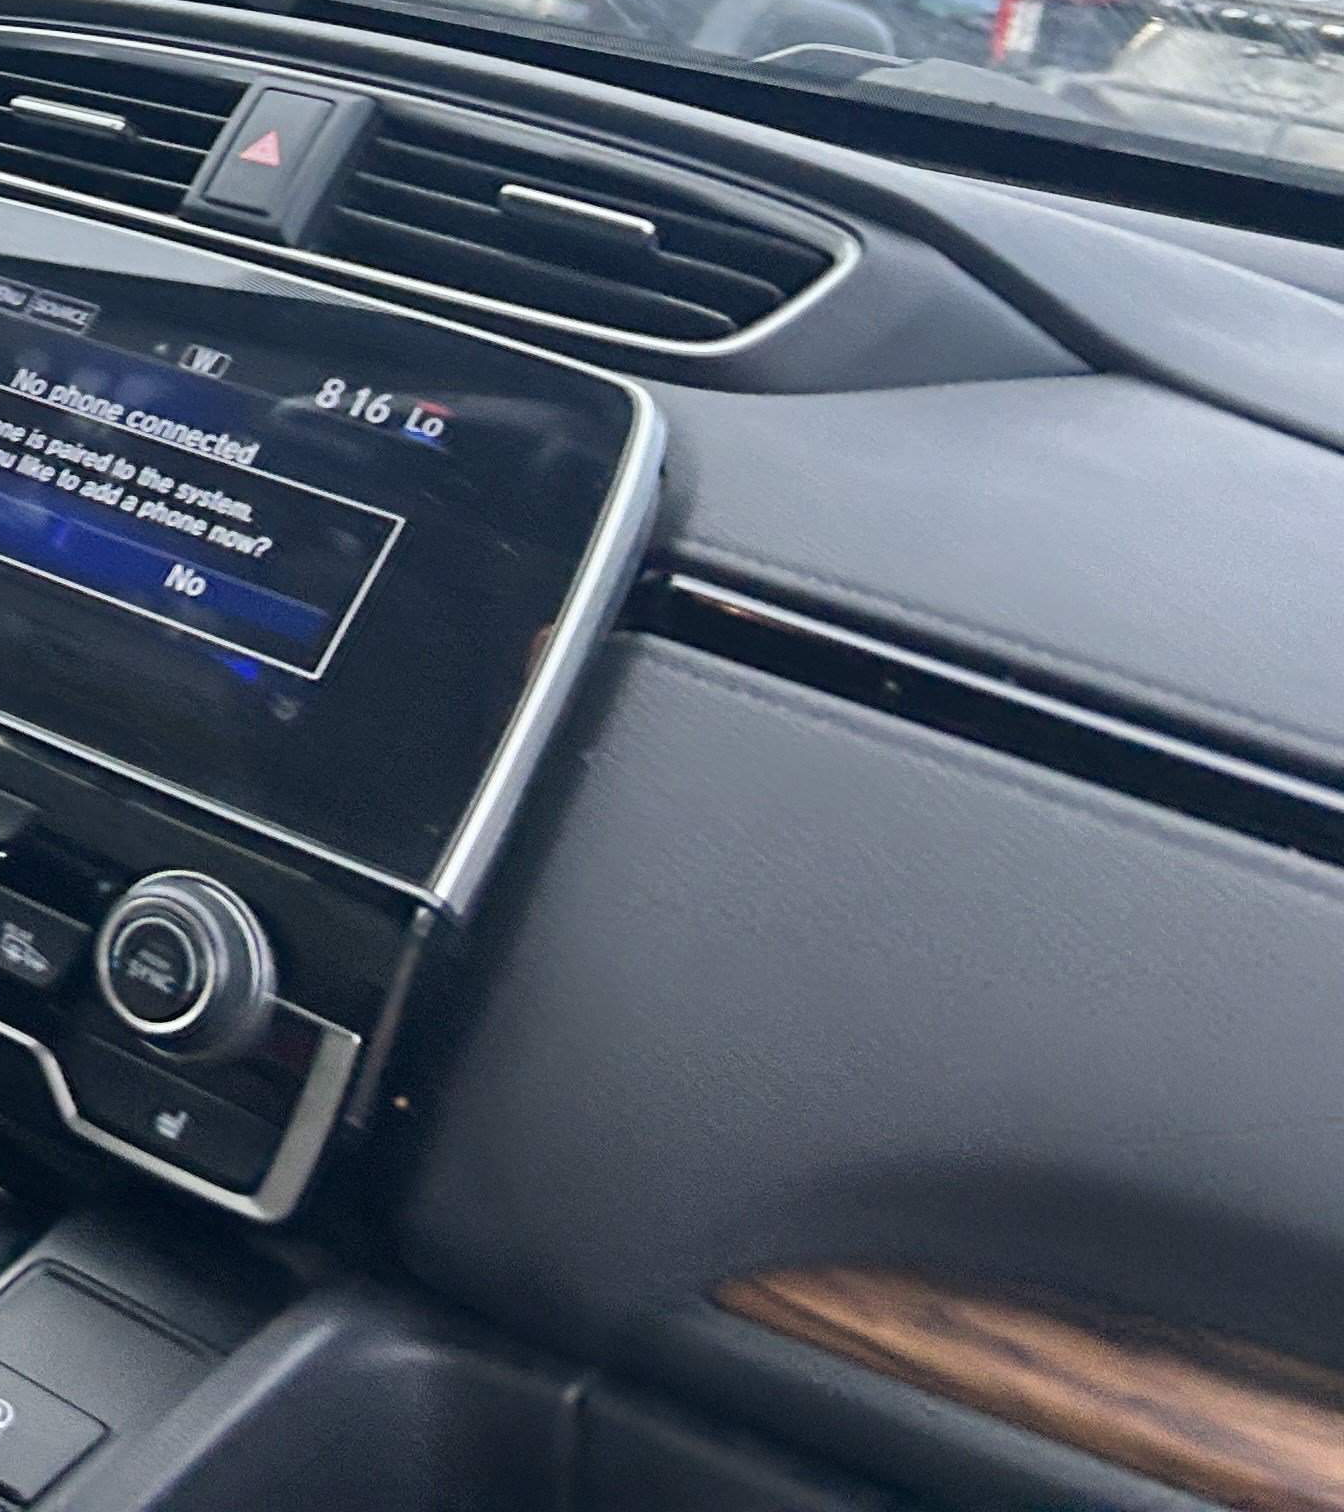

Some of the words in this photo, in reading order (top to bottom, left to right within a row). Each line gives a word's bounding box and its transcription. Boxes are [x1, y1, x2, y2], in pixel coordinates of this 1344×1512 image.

[11, 367, 49, 397] No
[48, 384, 125, 422] phone
[125, 408, 260, 467] connected
[25, 427, 47, 450] is
[44, 438, 115, 473] paired
[112, 456, 138, 481] to
[136, 466, 176, 495] the
[15, 453, 57, 483] like
[55, 469, 82, 492] to
[79, 479, 124, 507] add
[136, 501, 209, 537] phone
[207, 522, 274, 559] now?
[164, 563, 207, 597] No
